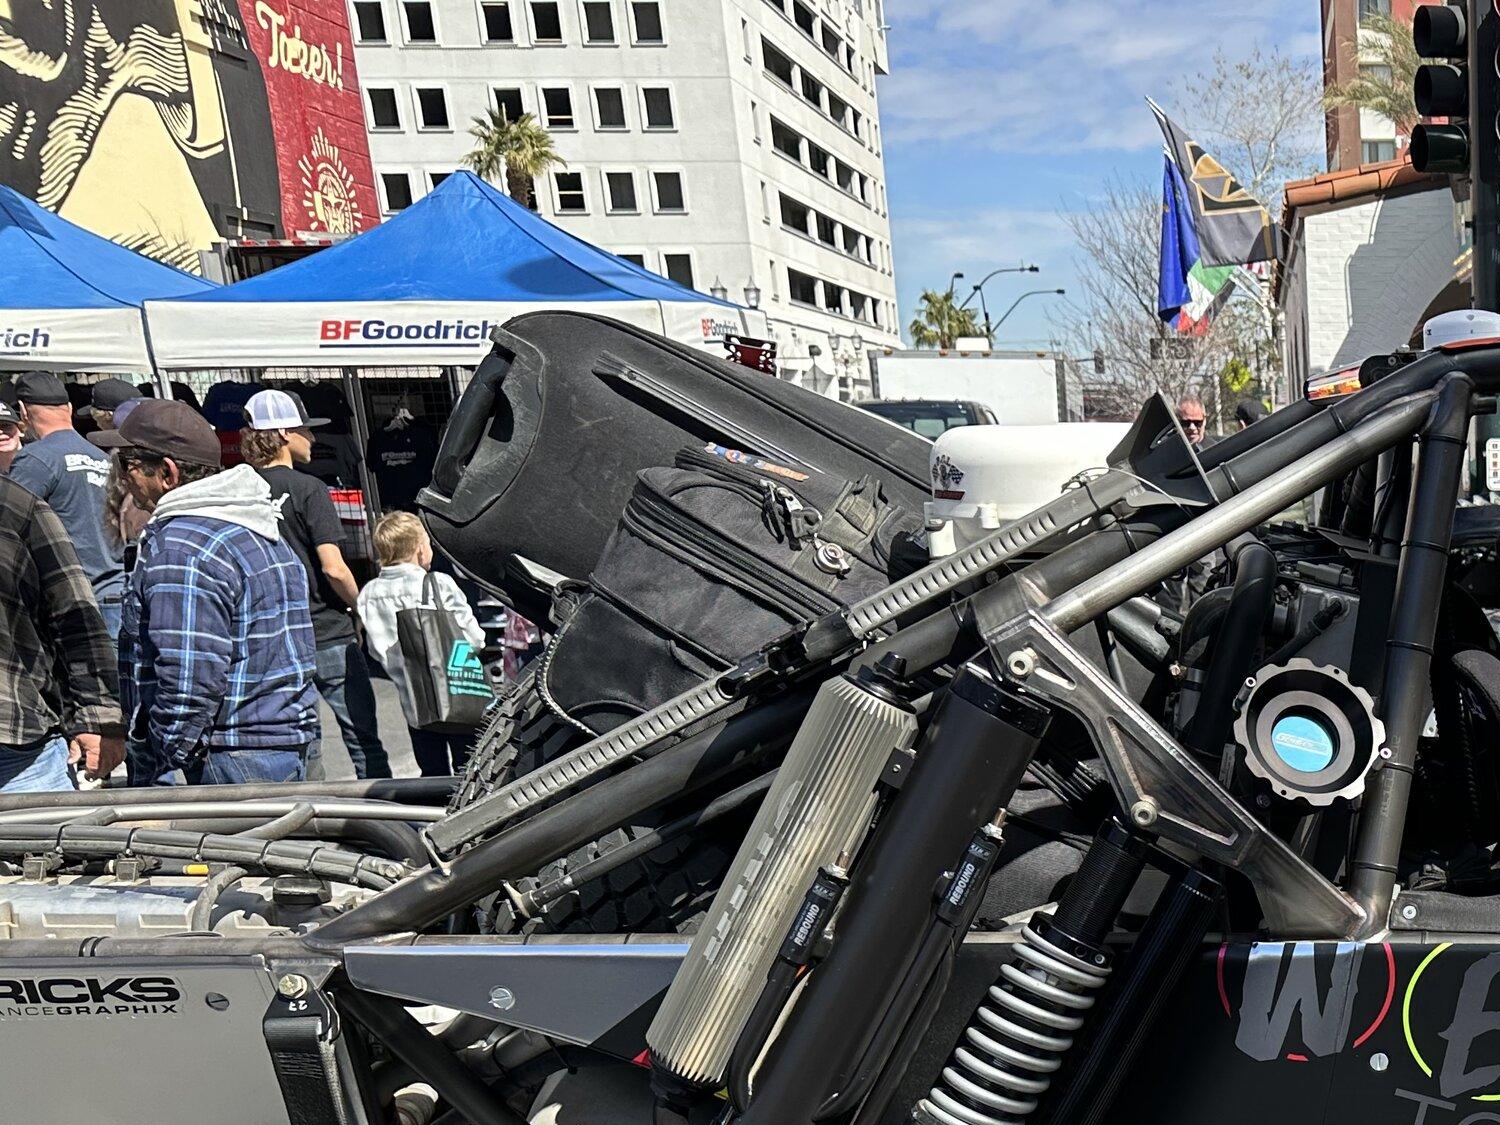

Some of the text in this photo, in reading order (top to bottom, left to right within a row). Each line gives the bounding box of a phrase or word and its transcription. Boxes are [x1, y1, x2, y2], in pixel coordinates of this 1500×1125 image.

[319, 319, 494, 341] BFGoodrich
[949, 862, 976, 906] REBOUND
[793, 903, 820, 946] REBOUND
